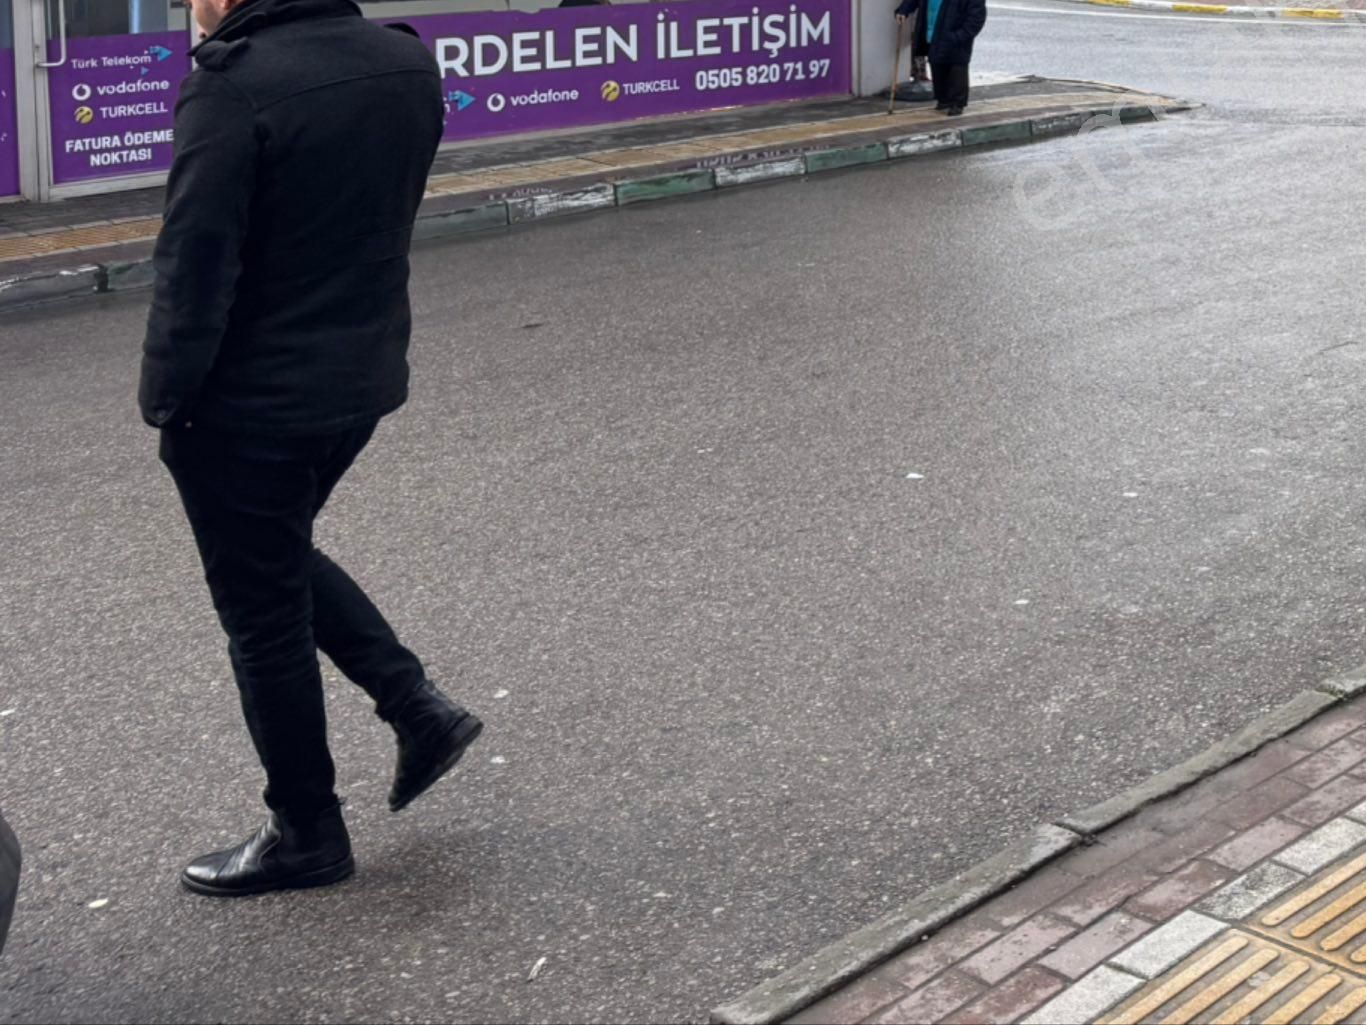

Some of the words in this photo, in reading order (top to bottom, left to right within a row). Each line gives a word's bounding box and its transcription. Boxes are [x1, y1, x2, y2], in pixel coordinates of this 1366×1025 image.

[435, 24, 638, 79] RDELEN
[656, 4, 831, 59] İLETİŞİM
[71, 57, 98, 69] Türk
[102, 53, 151, 66] Telekom
[695, 67, 742, 91] 0505
[746, 63, 781, 85] 820
[784, 61, 806, 81] 71
[809, 59, 831, 79] 97
[96, 79, 170, 95] vodafone
[623, 78, 680, 95] TURKCELL
[510, 89, 579, 106] vodafone
[100, 102, 168, 118] TURKCELL
[65, 135, 120, 153] FATURA
[124, 129, 174, 146] ÖDEME
[90, 148, 151, 166] NOKTASI
